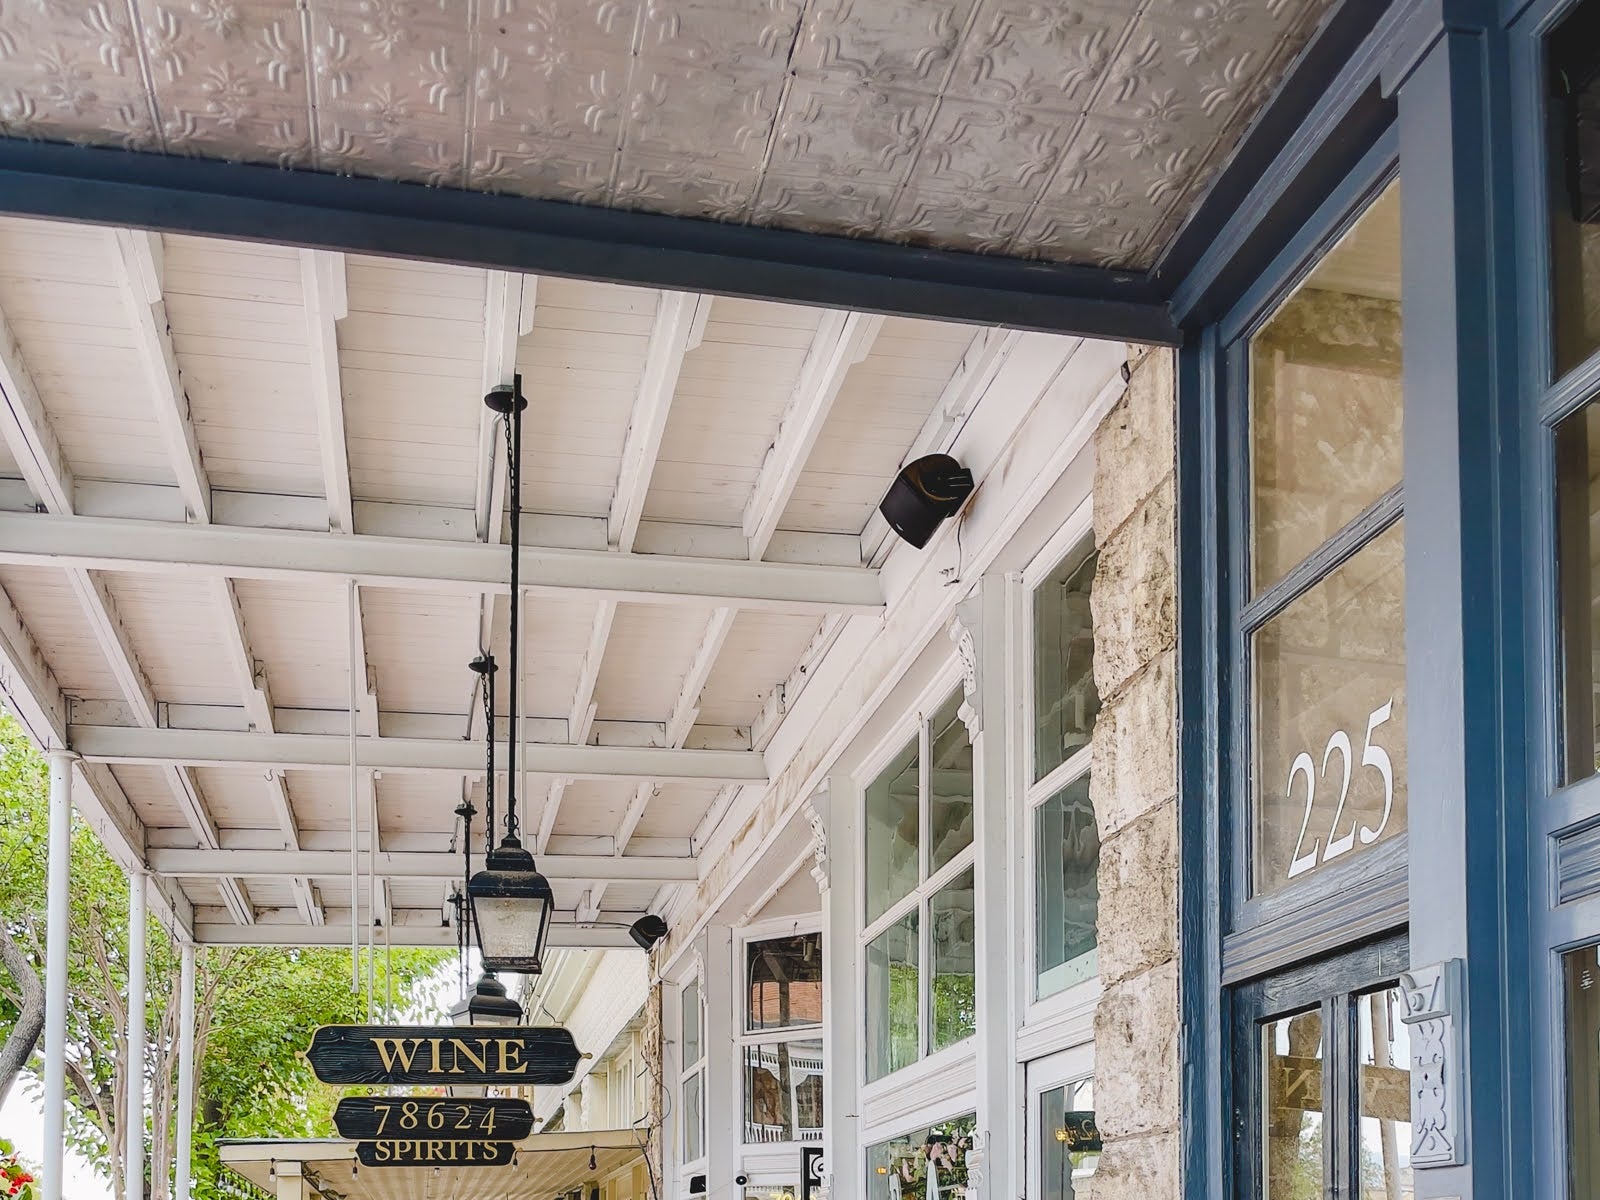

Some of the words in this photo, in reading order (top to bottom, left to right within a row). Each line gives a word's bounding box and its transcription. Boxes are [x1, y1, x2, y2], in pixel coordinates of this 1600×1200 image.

[1286, 696, 1394, 880] 225
[369, 1038, 529, 1074] WINE
[373, 1101, 497, 1136] 78624
[374, 1141, 499, 1162] SPIRITS
